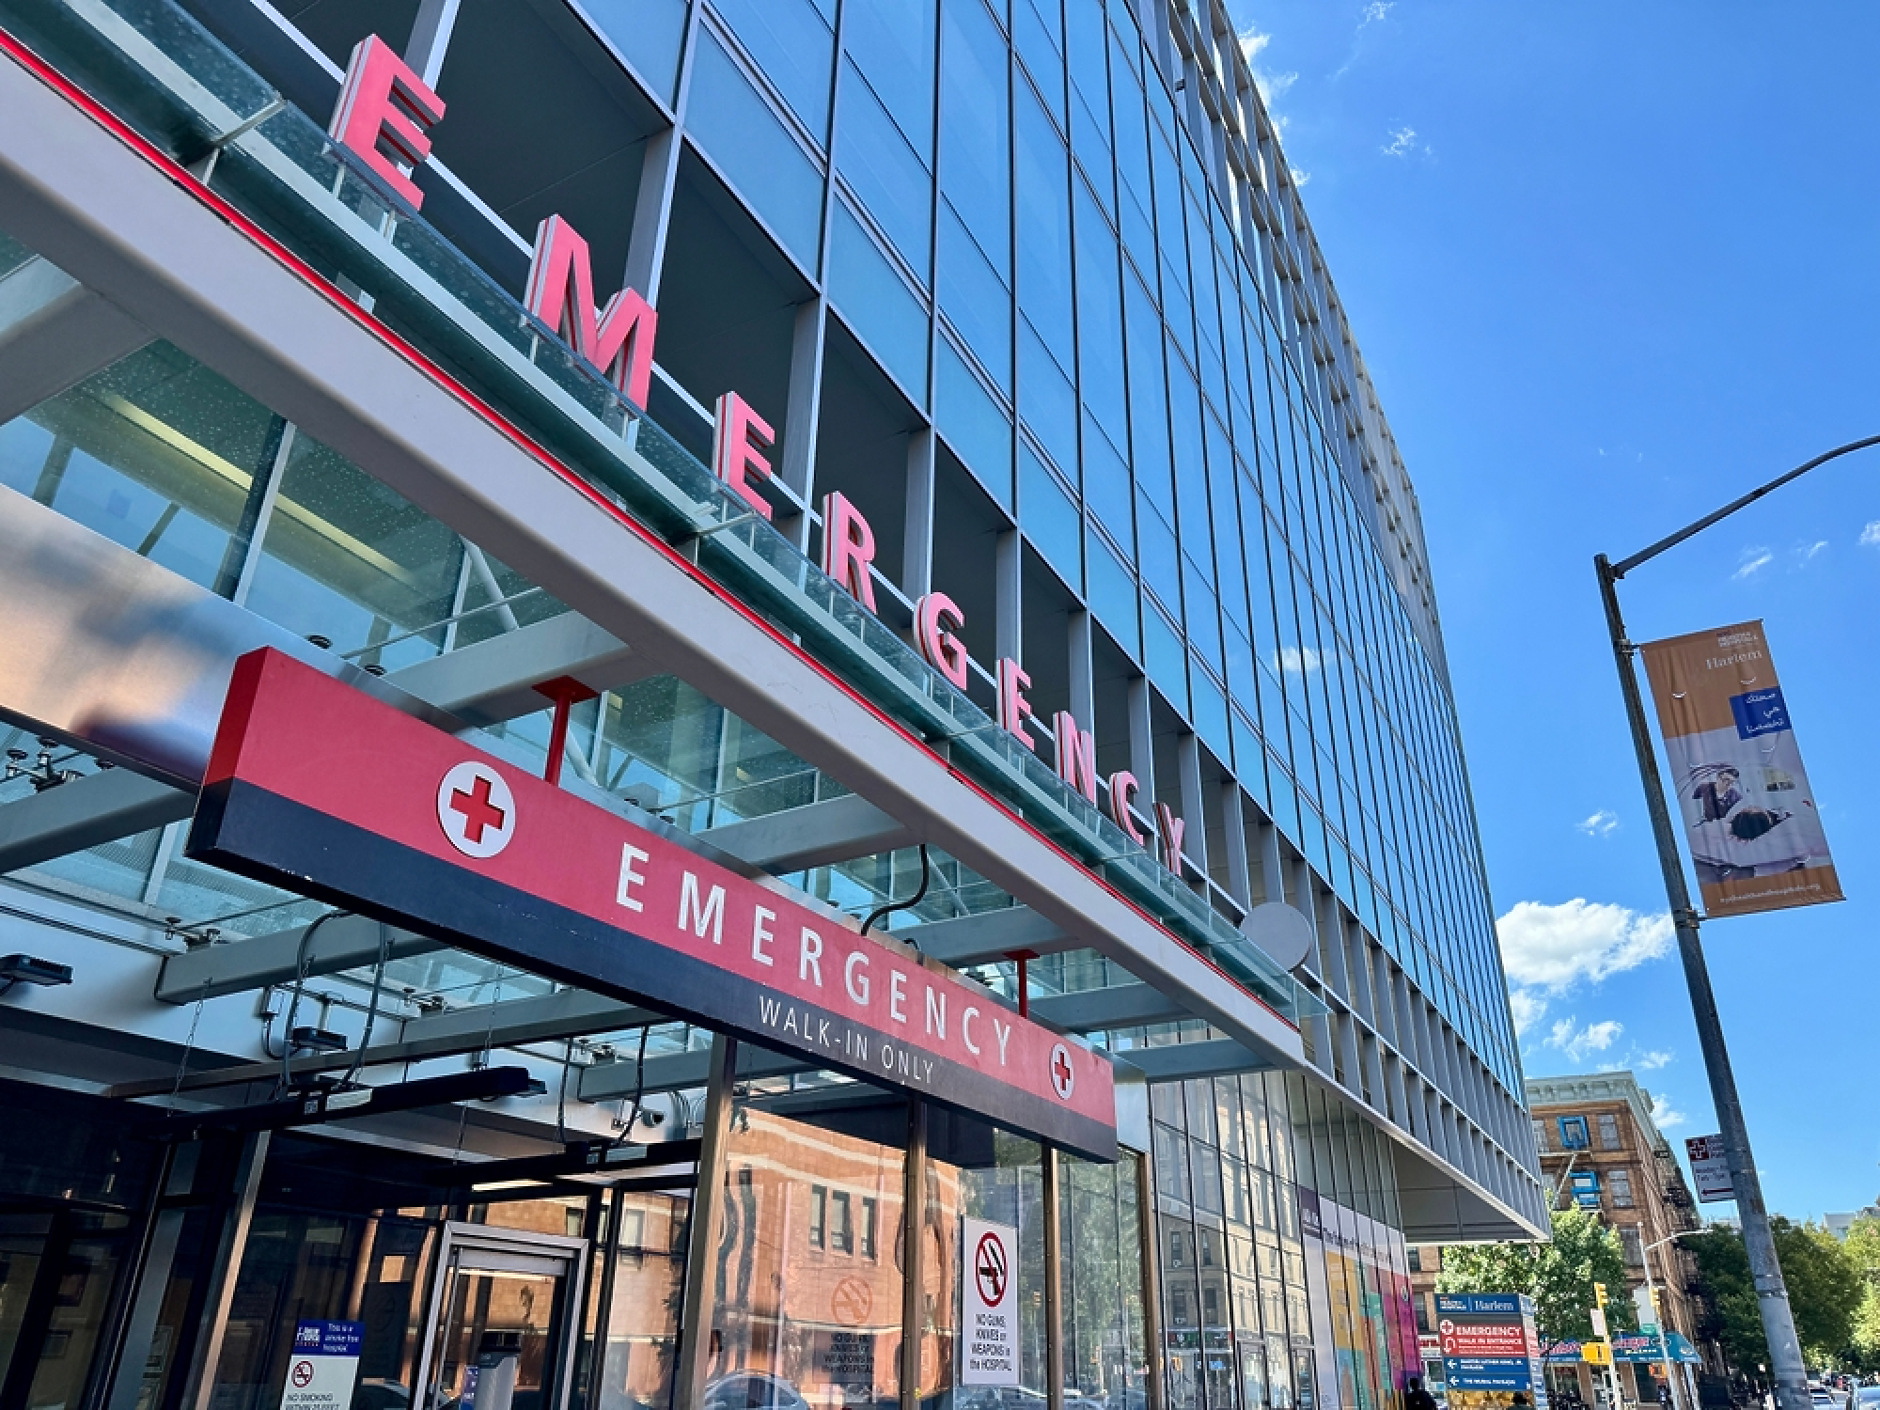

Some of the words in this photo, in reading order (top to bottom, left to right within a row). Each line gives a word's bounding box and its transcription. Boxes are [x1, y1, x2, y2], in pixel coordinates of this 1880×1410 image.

[323, 33, 1185, 876] EMERGENCY
[1706, 650, 1763, 670] Harlem
[615, 841, 1013, 1067] EMERGENCY
[759, 994, 869, 1062] WALK-IN
[880, 1043, 936, 1085] ONLY
[1475, 1300, 1514, 1311] Harlem
[976, 1313, 985, 1326] NO
[976, 1329, 999, 1341] KNIVES
[1456, 1326, 1522, 1336] EMERGENCY
[971, 1343, 1004, 1356] WEAPONS
[981, 1359, 1012, 1371] HOSPITAL
